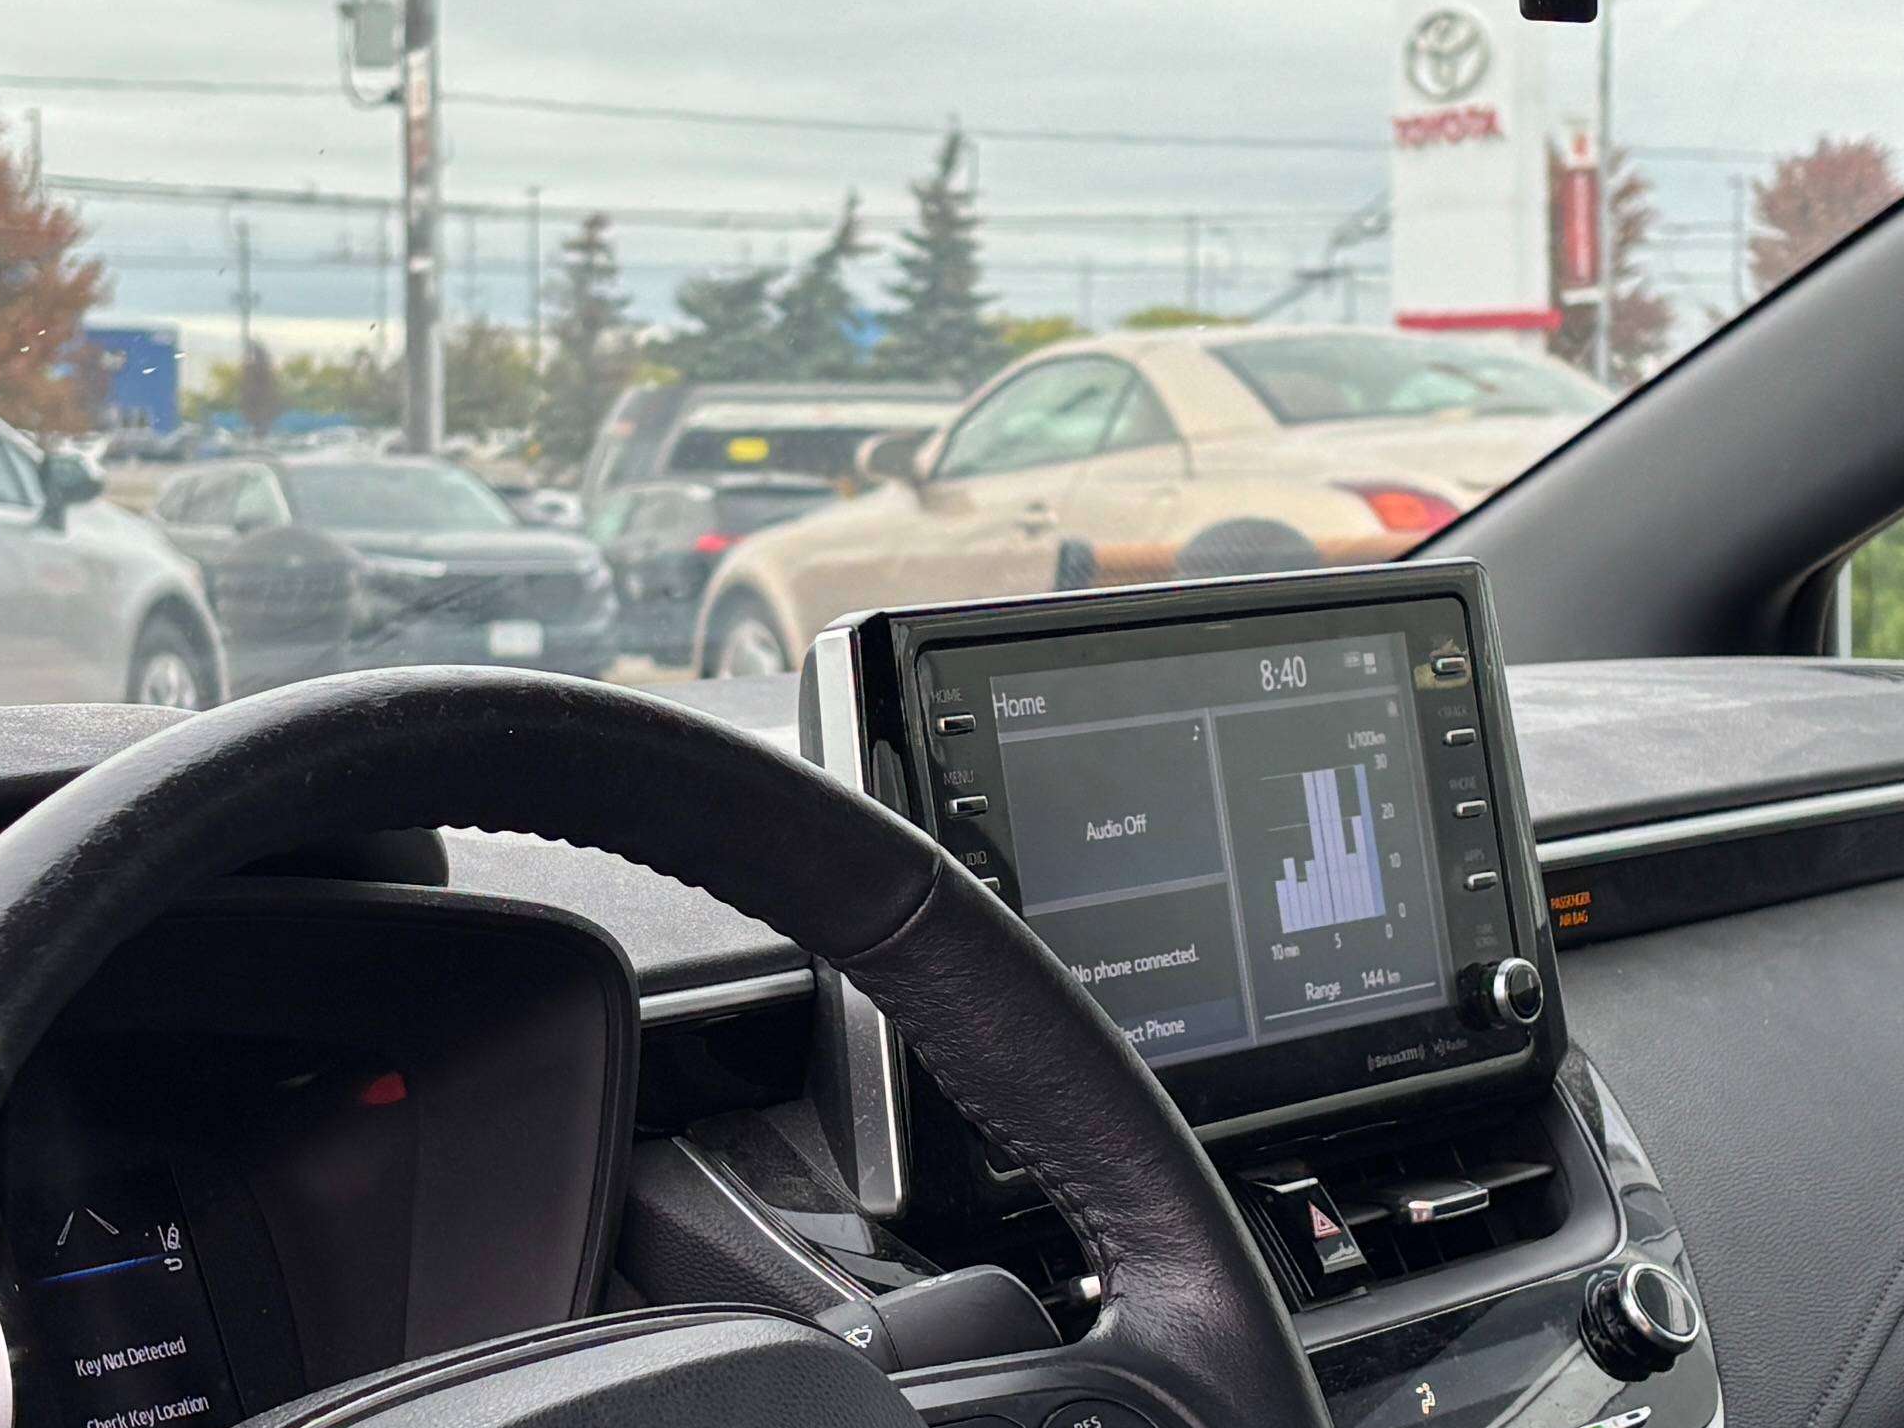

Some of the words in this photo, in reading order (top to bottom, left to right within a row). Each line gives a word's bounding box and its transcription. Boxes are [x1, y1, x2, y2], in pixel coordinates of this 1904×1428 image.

[1393, 104, 1502, 149] TOYOTA
[1259, 655, 1307, 692] 8:40
[992, 691, 1047, 719] Home
[1373, 752, 1388, 771] 30
[943, 769, 975, 787] MENU
[1380, 802, 1395, 820] 20
[1086, 818, 1123, 842] Audio
[1124, 813, 1147, 835] Off
[959, 850, 988, 868] UDIO
[1389, 852, 1402, 869] 10
[1398, 902, 1406, 918] 0
[1550, 890, 1592, 910] PASSENGER
[1334, 932, 1342, 949] 5
[1385, 923, 1394, 939] 0
[1271, 944, 1284, 960] 10
[1071, 962, 1092, 984] No
[1094, 960, 1132, 984] phone
[1134, 943, 1200, 972] connected.
[1304, 980, 1342, 1001] Range
[1361, 968, 1385, 989] 144
[1145, 1018, 1185, 1041] Phone
[75, 1358, 102, 1377] Key
[102, 1351, 128, 1371] Not
[127, 1335, 187, 1365] Detected
[128, 1408, 154, 1428] Key
[155, 1395, 210, 1421] Location
